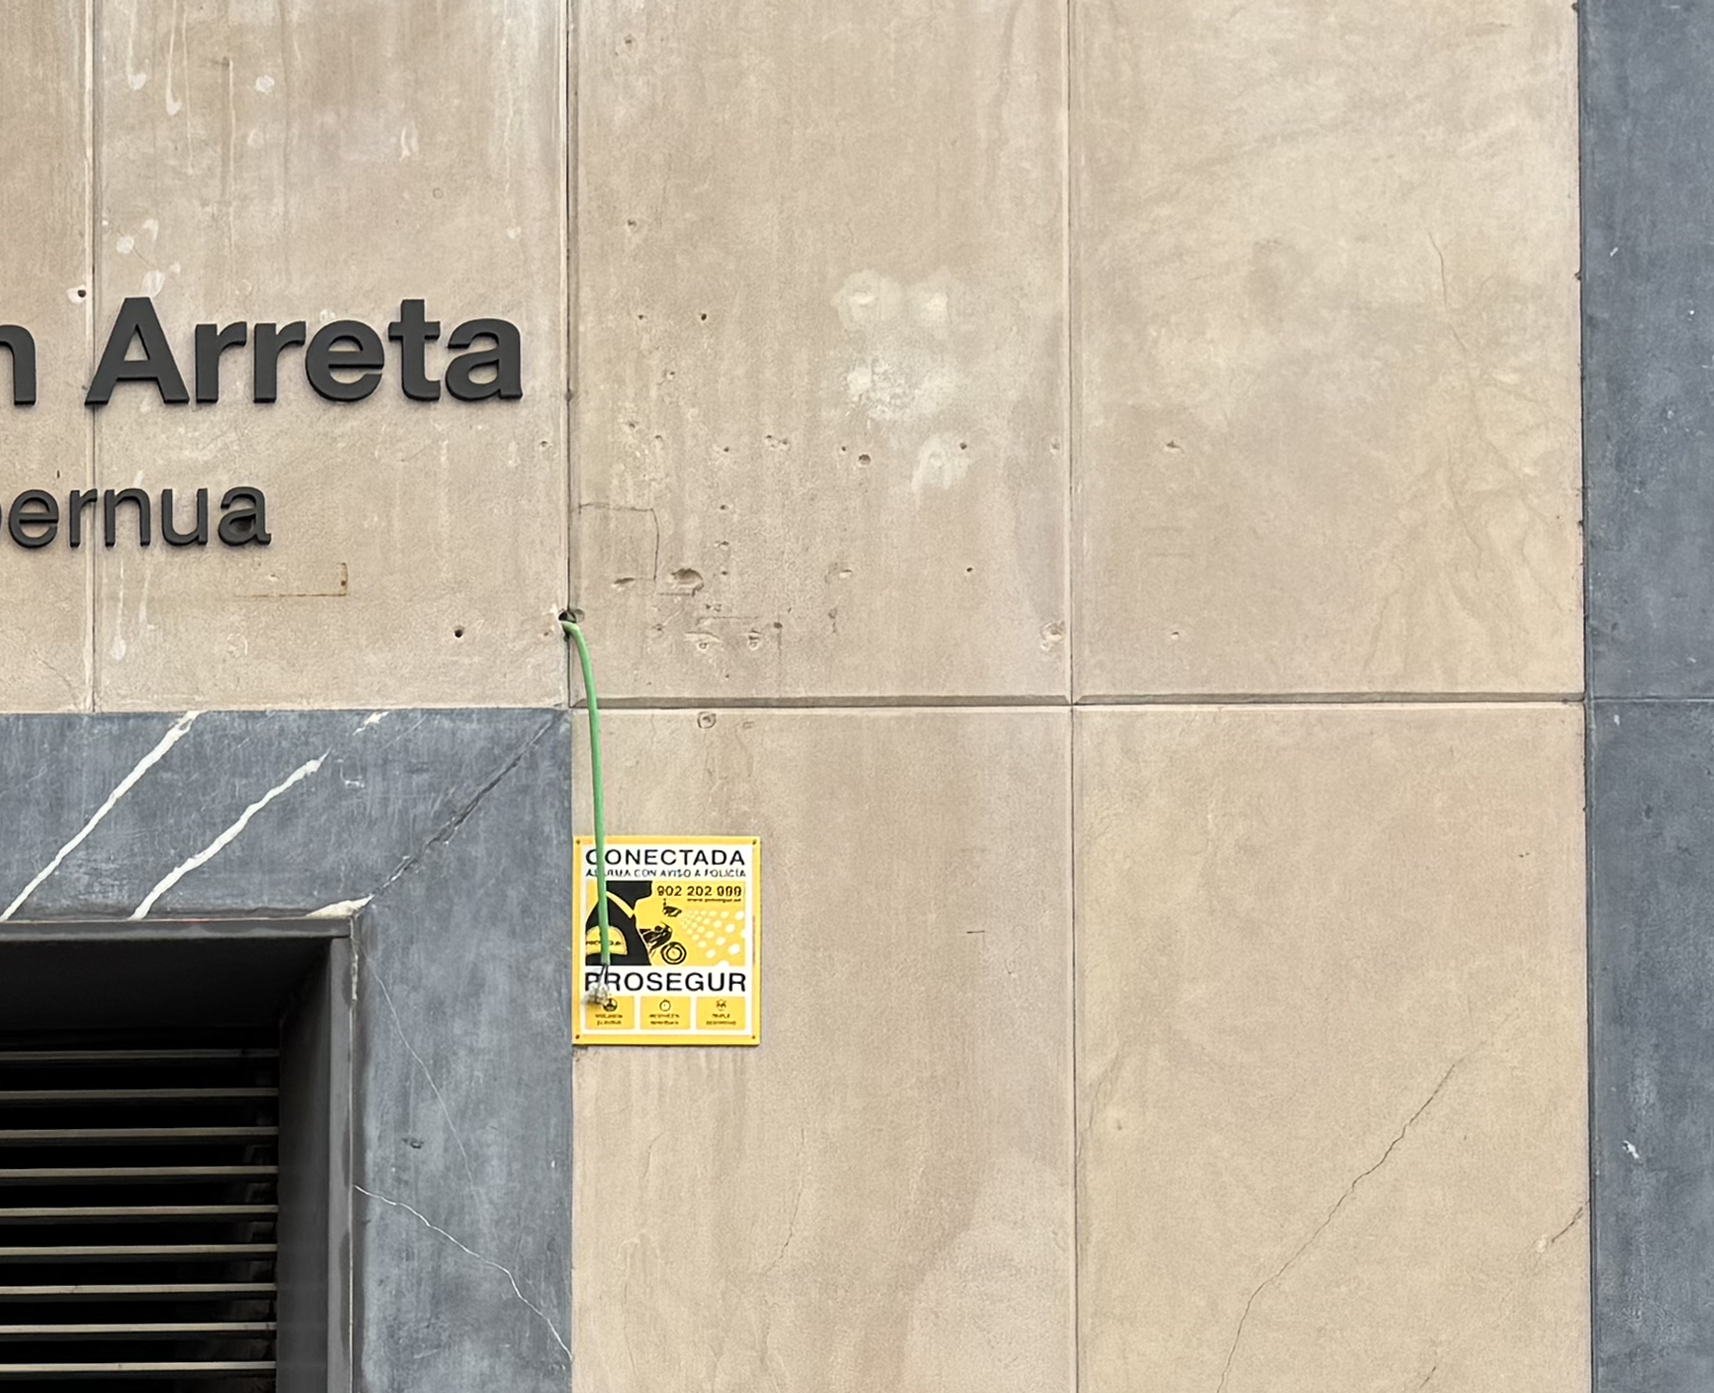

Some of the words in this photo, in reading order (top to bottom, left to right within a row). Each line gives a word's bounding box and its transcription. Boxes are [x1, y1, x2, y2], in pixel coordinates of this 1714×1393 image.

[85, 296, 524, 403] Arreta
[634, 869, 656, 877] CON
[687, 886, 712, 896] 202
[585, 972, 746, 992] PROSEGUR
